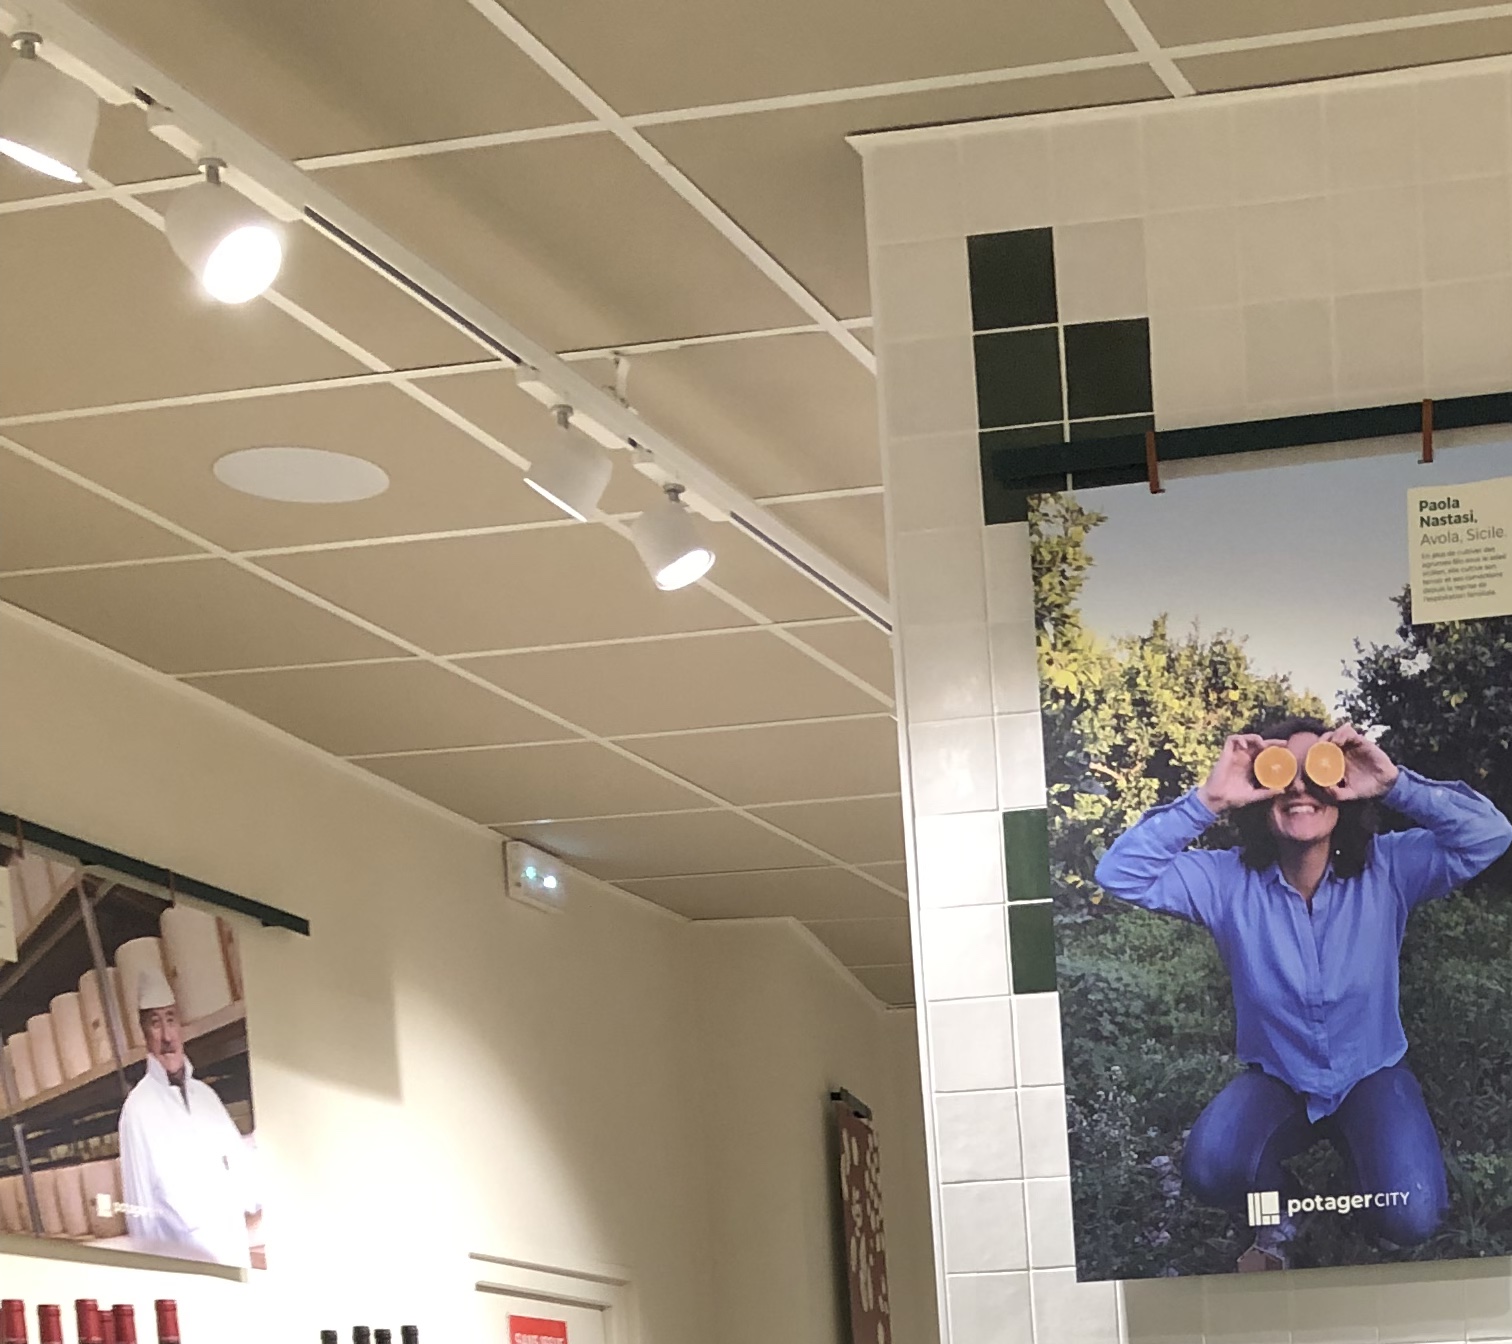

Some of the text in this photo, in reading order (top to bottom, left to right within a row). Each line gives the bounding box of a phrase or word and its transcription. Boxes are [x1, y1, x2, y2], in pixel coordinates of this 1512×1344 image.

[1419, 497, 1460, 512] Paola
[1420, 509, 1478, 528] Nastasi.
[1420, 531, 1463, 546] Avola,
